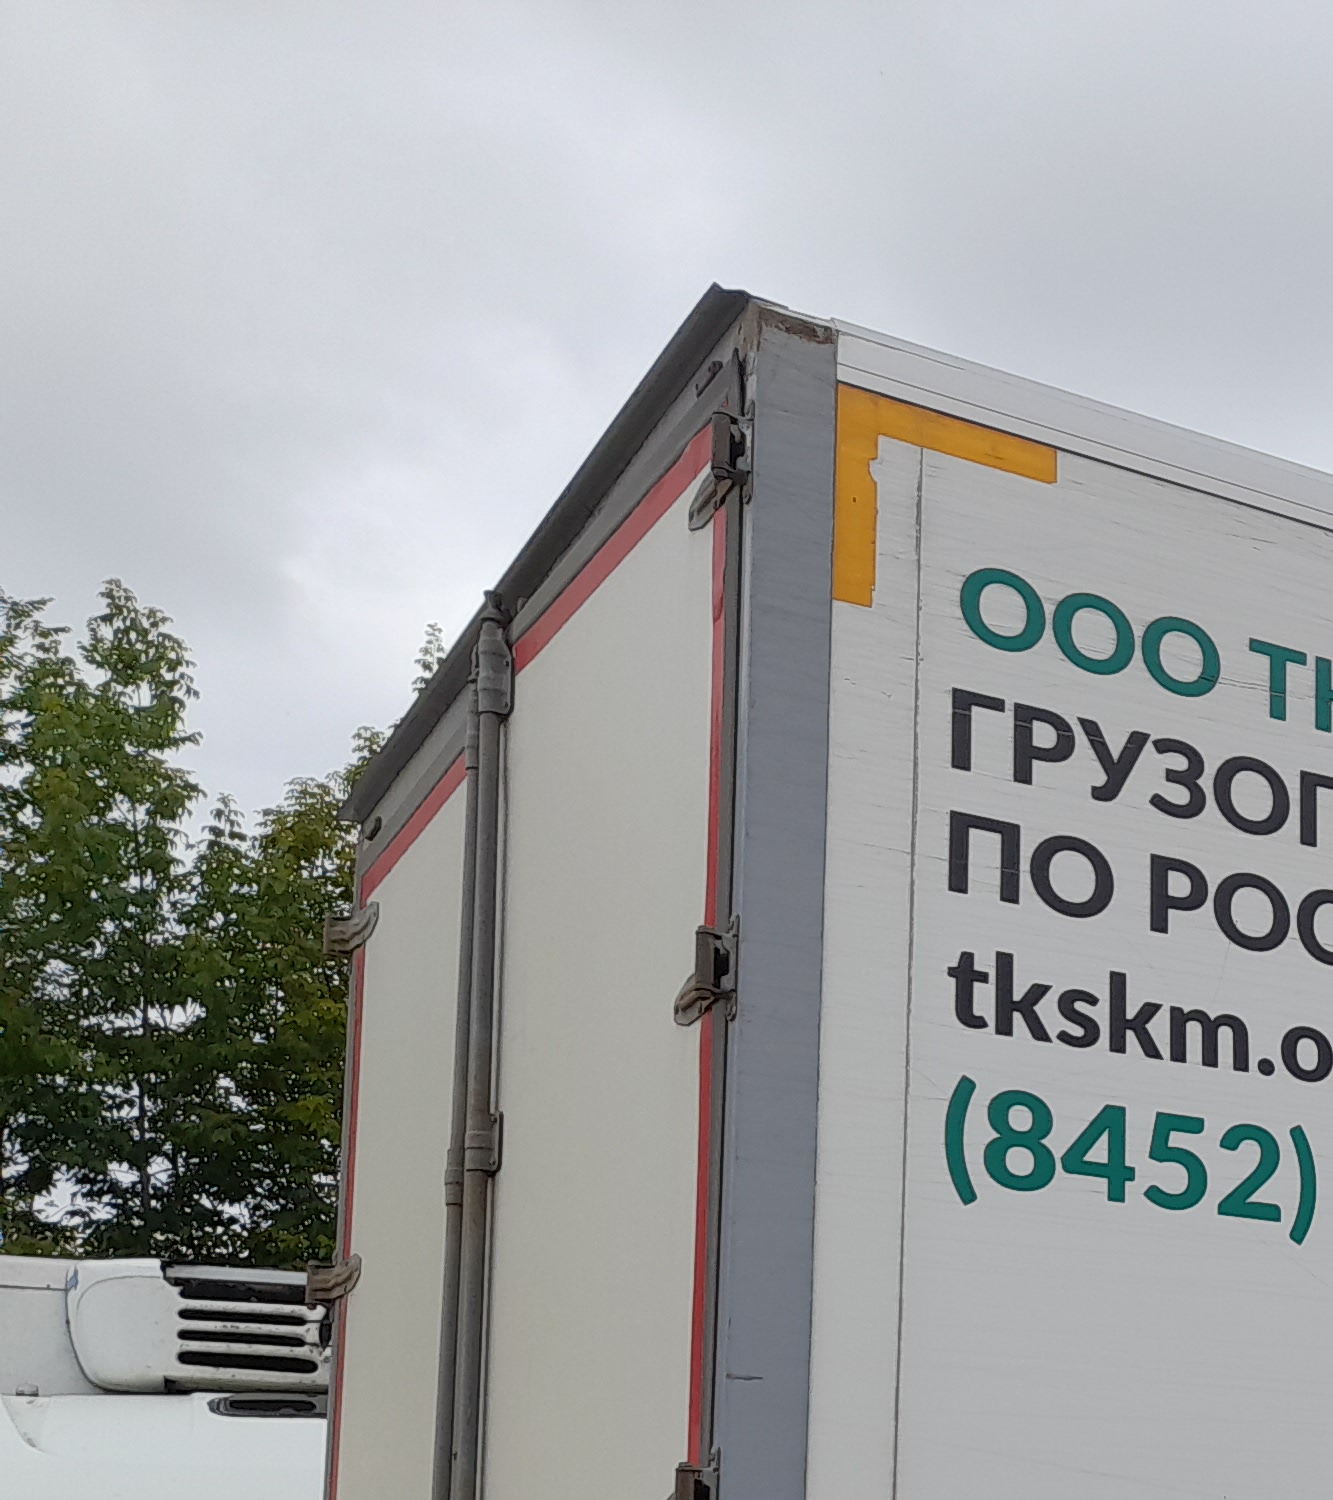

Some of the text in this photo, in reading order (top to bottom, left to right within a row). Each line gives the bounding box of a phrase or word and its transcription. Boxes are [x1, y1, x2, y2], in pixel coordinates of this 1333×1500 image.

[961, 566, 1220, 697] ООО
[947, 810, 1113, 918] ПО
[944, 1074, 1317, 1245] (8452)
